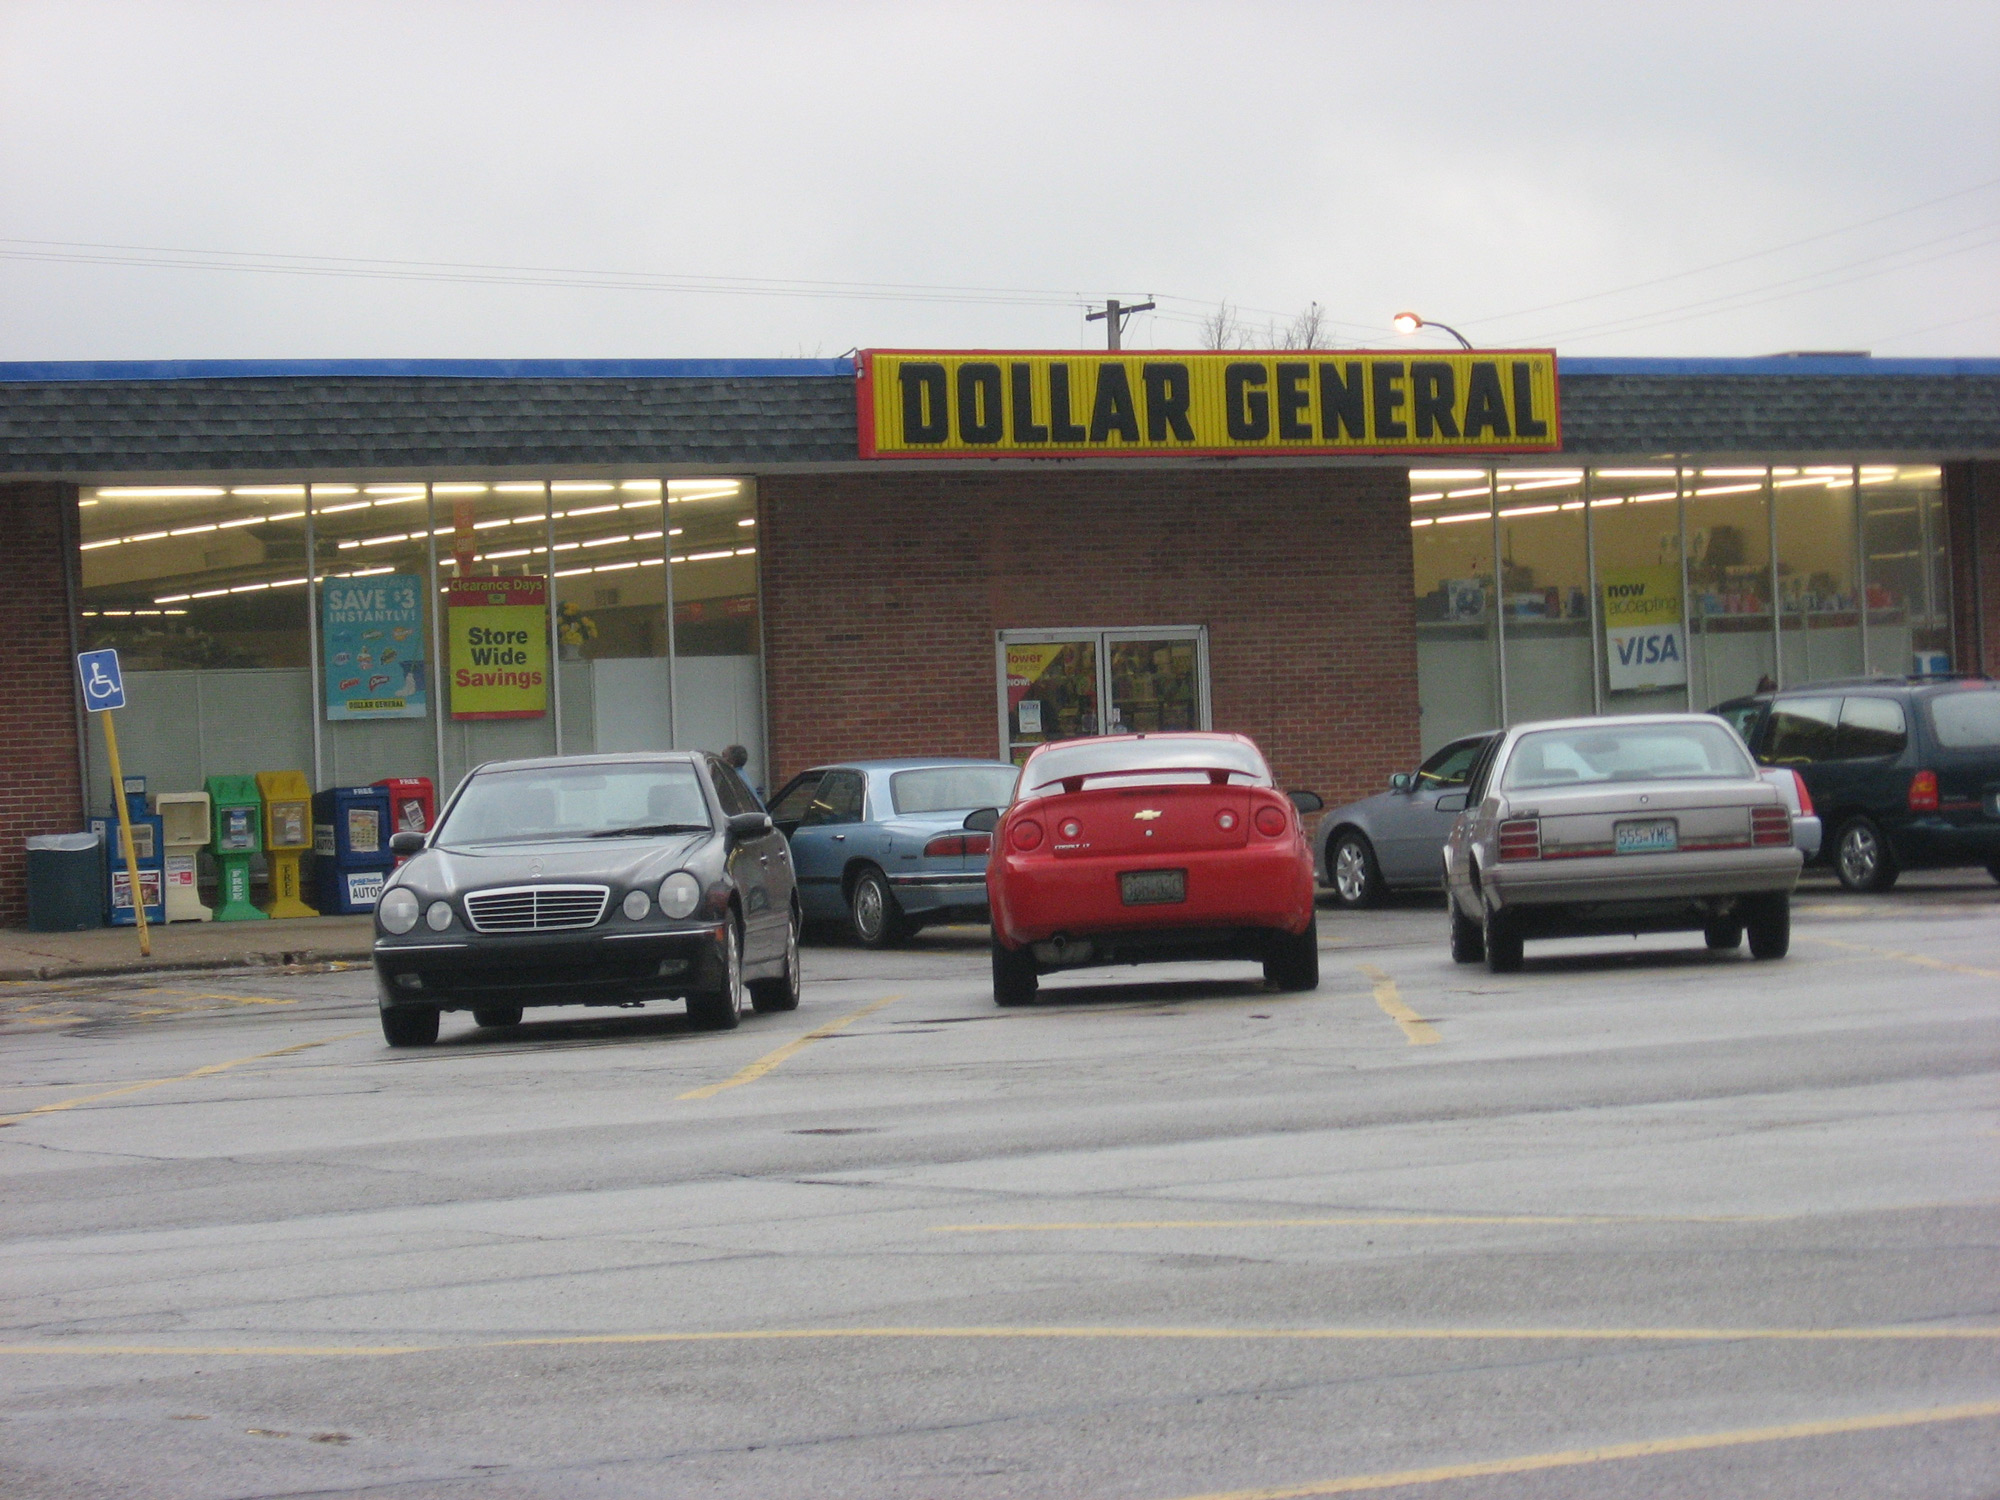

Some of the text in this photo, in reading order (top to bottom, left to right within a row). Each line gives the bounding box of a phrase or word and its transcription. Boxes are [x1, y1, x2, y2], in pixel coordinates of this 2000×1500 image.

[899, 360, 1549, 445] DOLLAR GENERAL
[451, 579, 543, 595] Clearance Days
[1608, 583, 1645, 597] now
[329, 589, 386, 610] SAVE
[1609, 597, 1678, 615] accepting
[329, 609, 416, 622] INSTANTLY!
[468, 627, 528, 646] Store
[471, 648, 527, 666] Wide
[1007, 653, 1043, 663] lower
[1612, 633, 1680, 666] VISA
[456, 669, 542, 689] Savings
[232, 869, 243, 901] FREE
[283, 864, 292, 897] FREE
